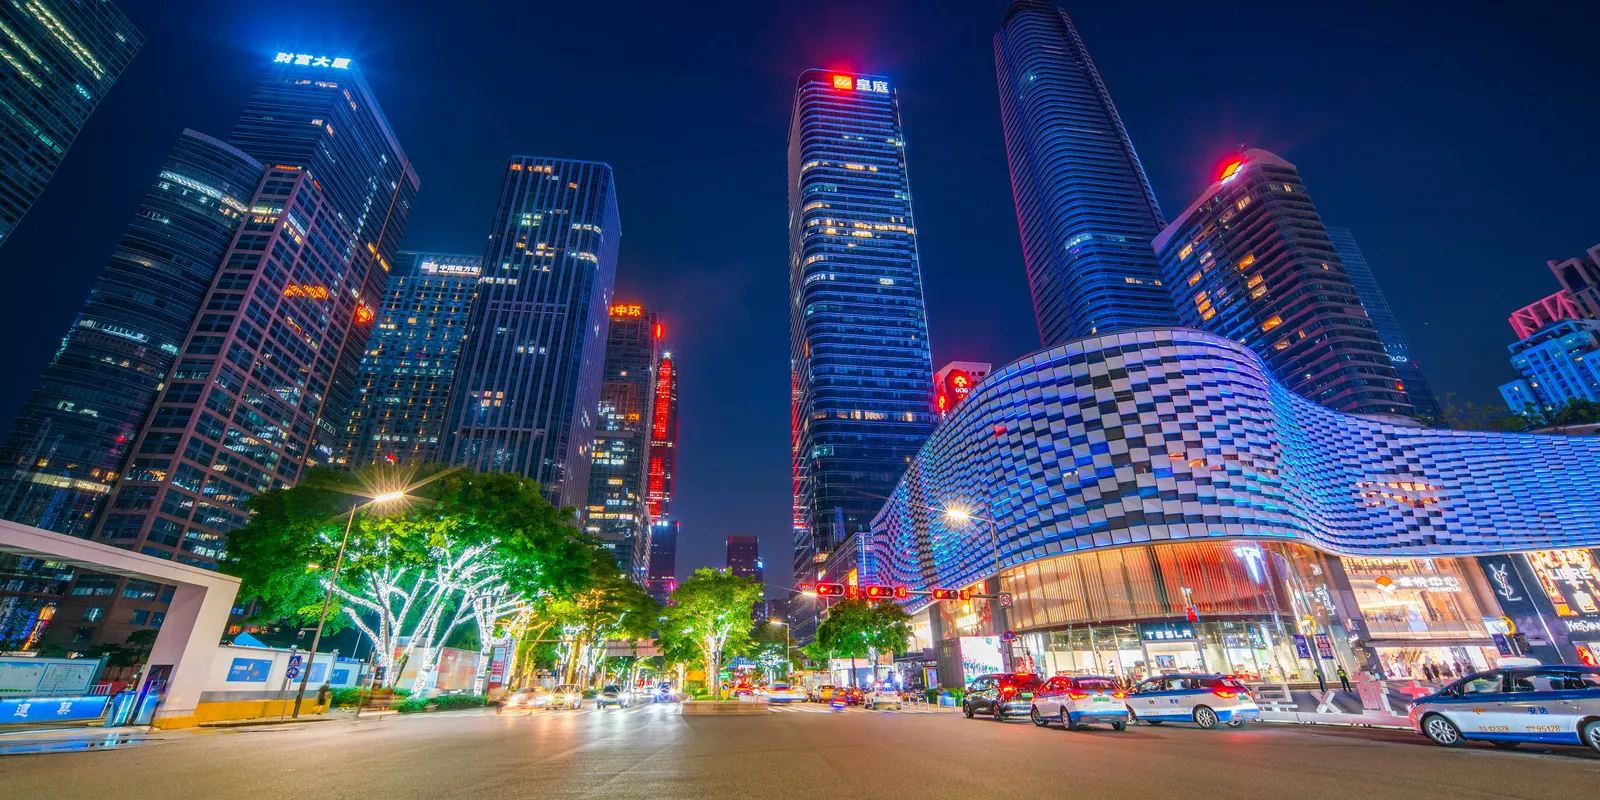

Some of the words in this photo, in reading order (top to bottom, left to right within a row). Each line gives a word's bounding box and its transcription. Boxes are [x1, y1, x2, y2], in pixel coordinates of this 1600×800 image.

[856, 78, 889, 93] 皇庭
[439, 264, 482, 273] 中国南方电
[1145, 630, 1193, 640] TESLA
[1527, 706, 1549, 715] 安达
